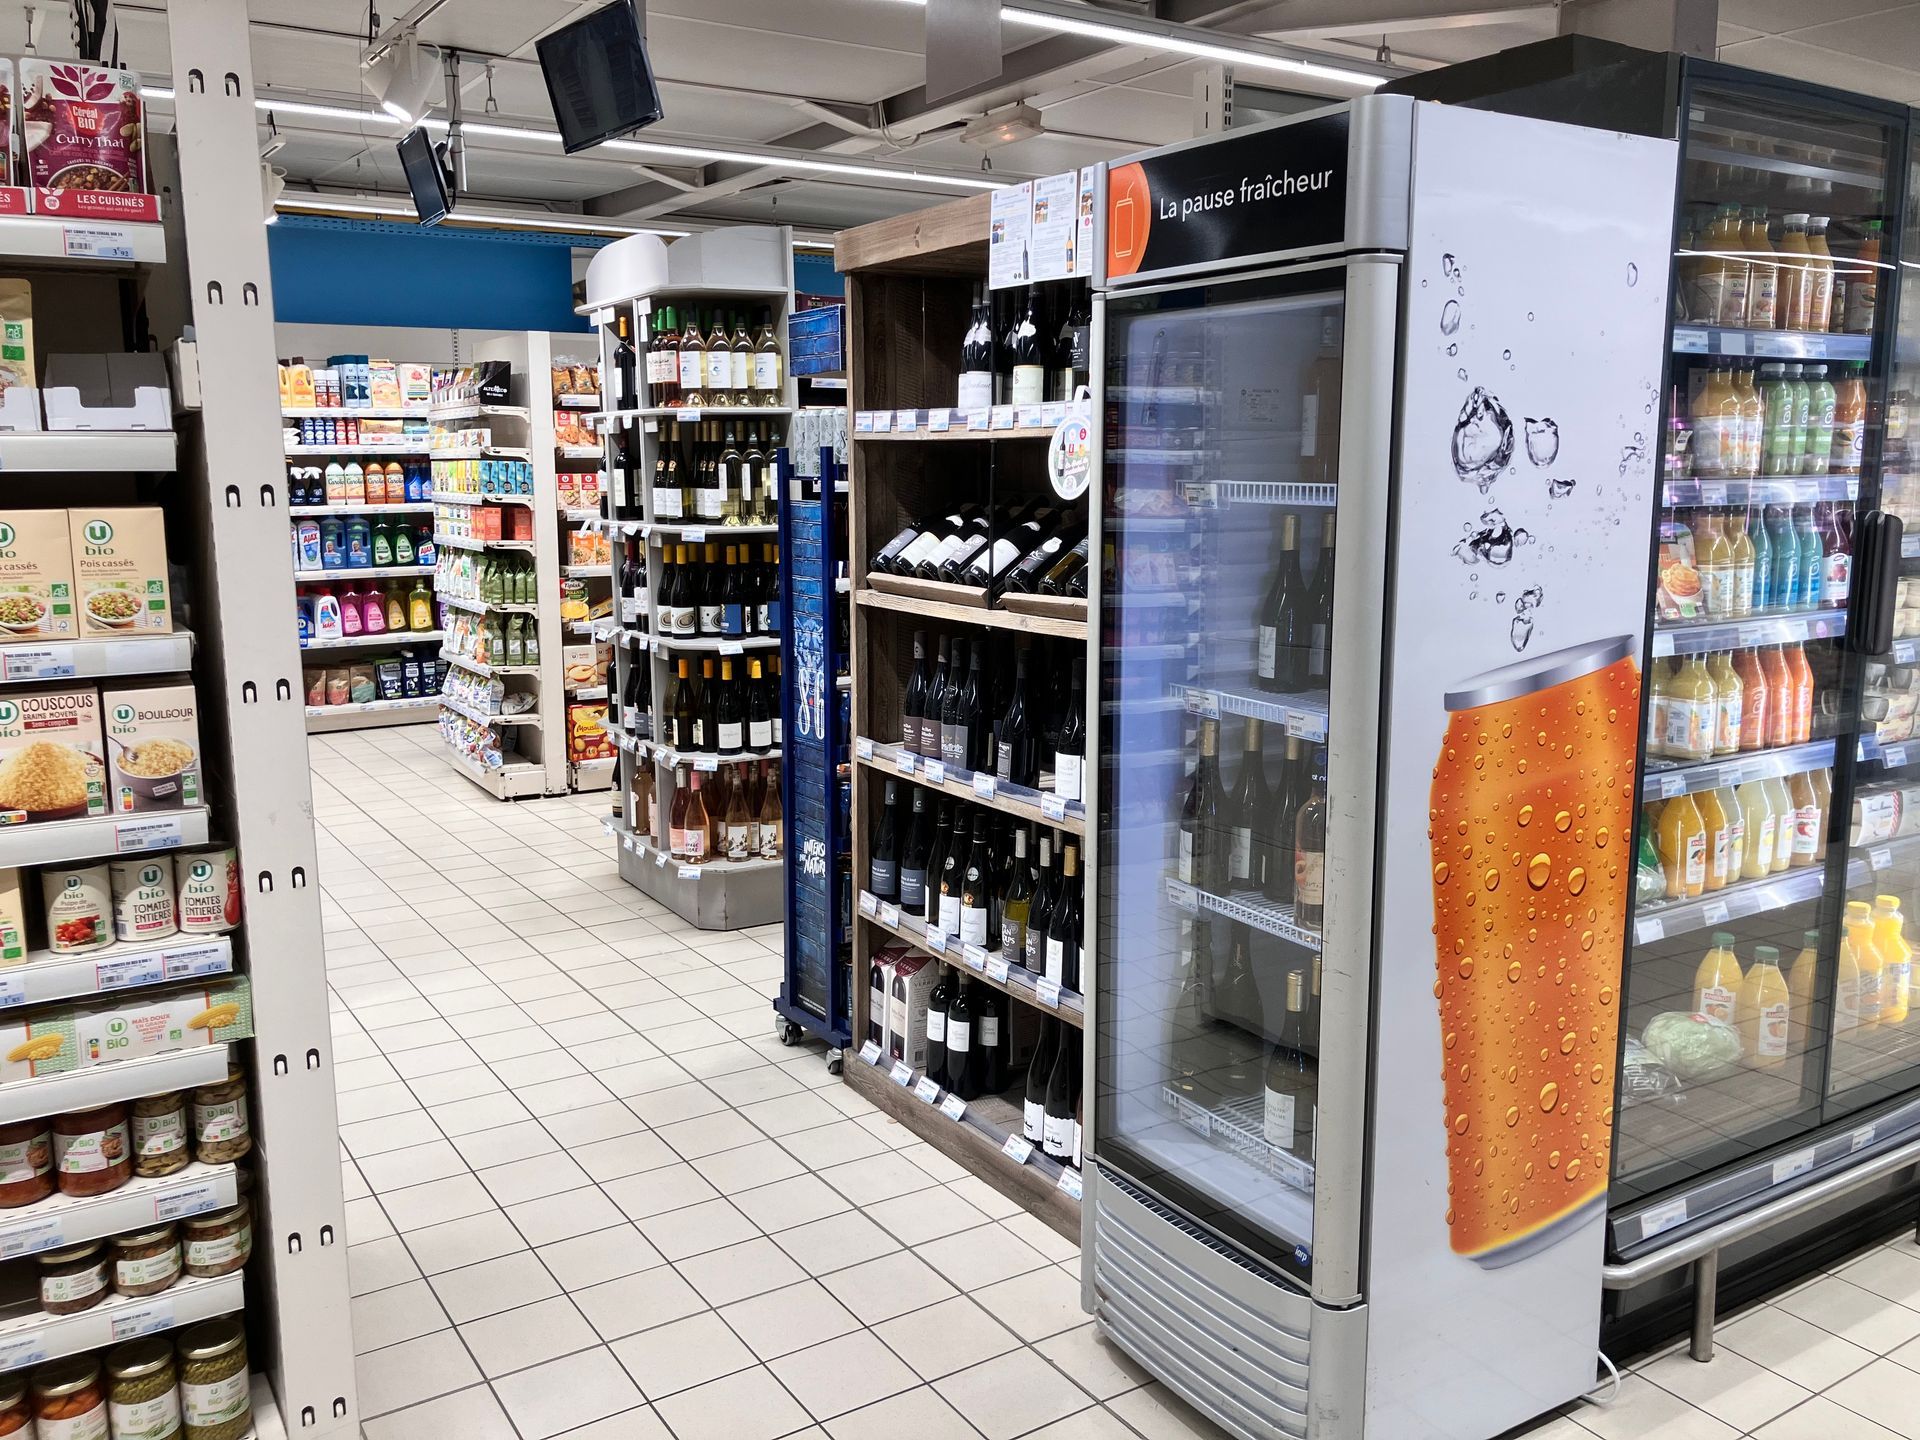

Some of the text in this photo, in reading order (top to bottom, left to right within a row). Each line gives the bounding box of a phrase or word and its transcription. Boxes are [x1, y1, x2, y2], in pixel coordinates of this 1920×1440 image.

[77, 117, 96, 130] BIO
[56, 133, 94, 148] Curry
[76, 194, 145, 208] LES CUISINÉS
[1160, 169, 1333, 222] La pause fraîcheur
[80, 558, 135, 568] Pois cassés
[21, 694, 94, 712] COUSCOUS
[138, 708, 194, 721] BOULGOUR
[133, 899, 171, 914] TOMATES
[184, 895, 221, 906] TOMATES
[106, 1037, 129, 1050] BIO
